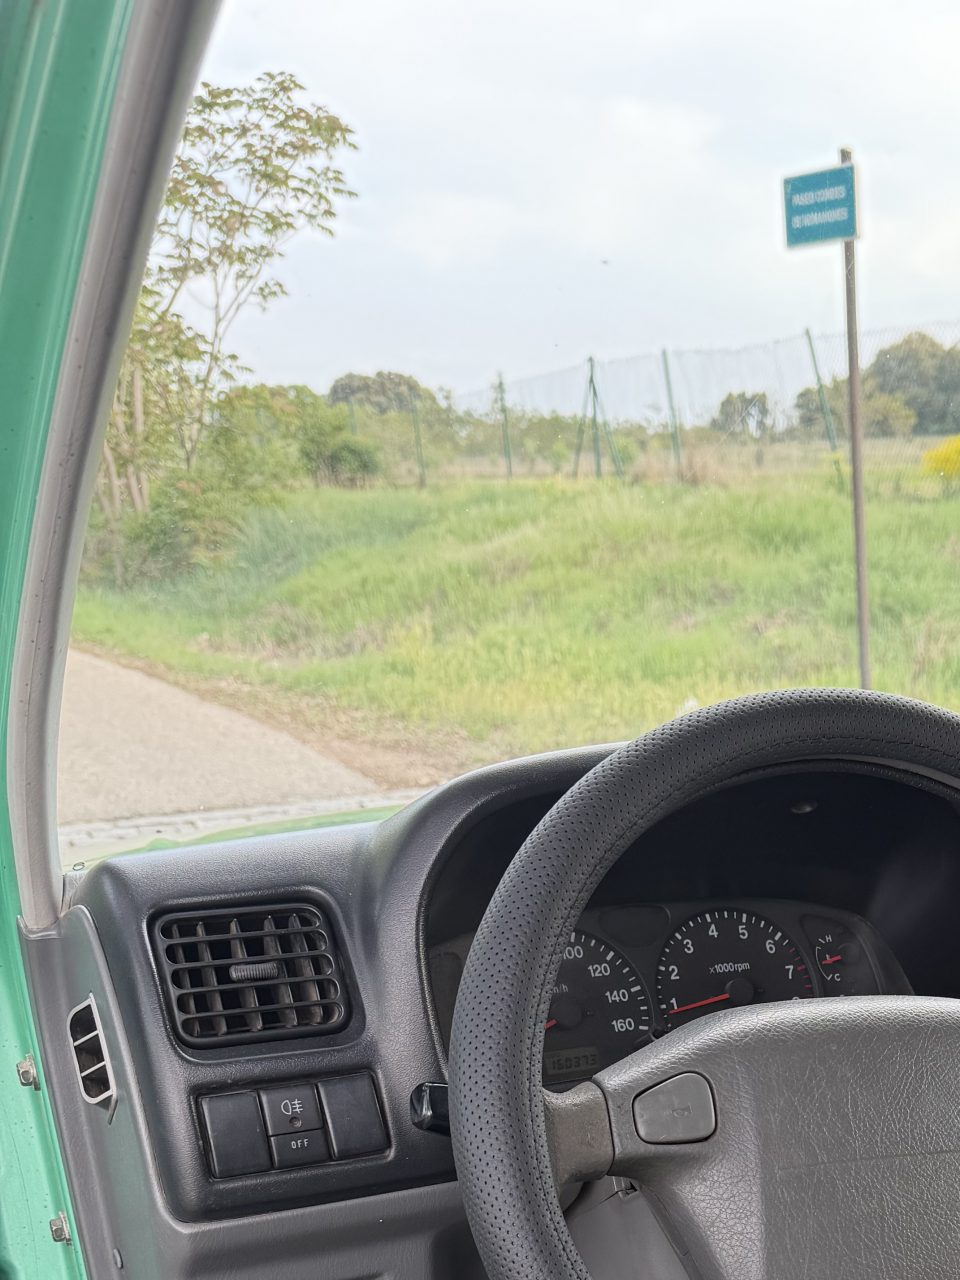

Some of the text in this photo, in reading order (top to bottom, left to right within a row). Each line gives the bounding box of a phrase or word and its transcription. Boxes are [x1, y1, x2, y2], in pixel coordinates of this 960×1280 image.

[708, 923, 718, 938] 4
[738, 924, 749, 939] 5
[683, 939, 694, 954] 3
[765, 939, 776, 954] 6
[588, 963, 611, 977] 120
[669, 965, 680, 980] 2
[785, 965, 794, 979] 7
[605, 989, 629, 1003] 140
[611, 1018, 635, 1032] 160
[290, 1138, 310, 1150] OFF
